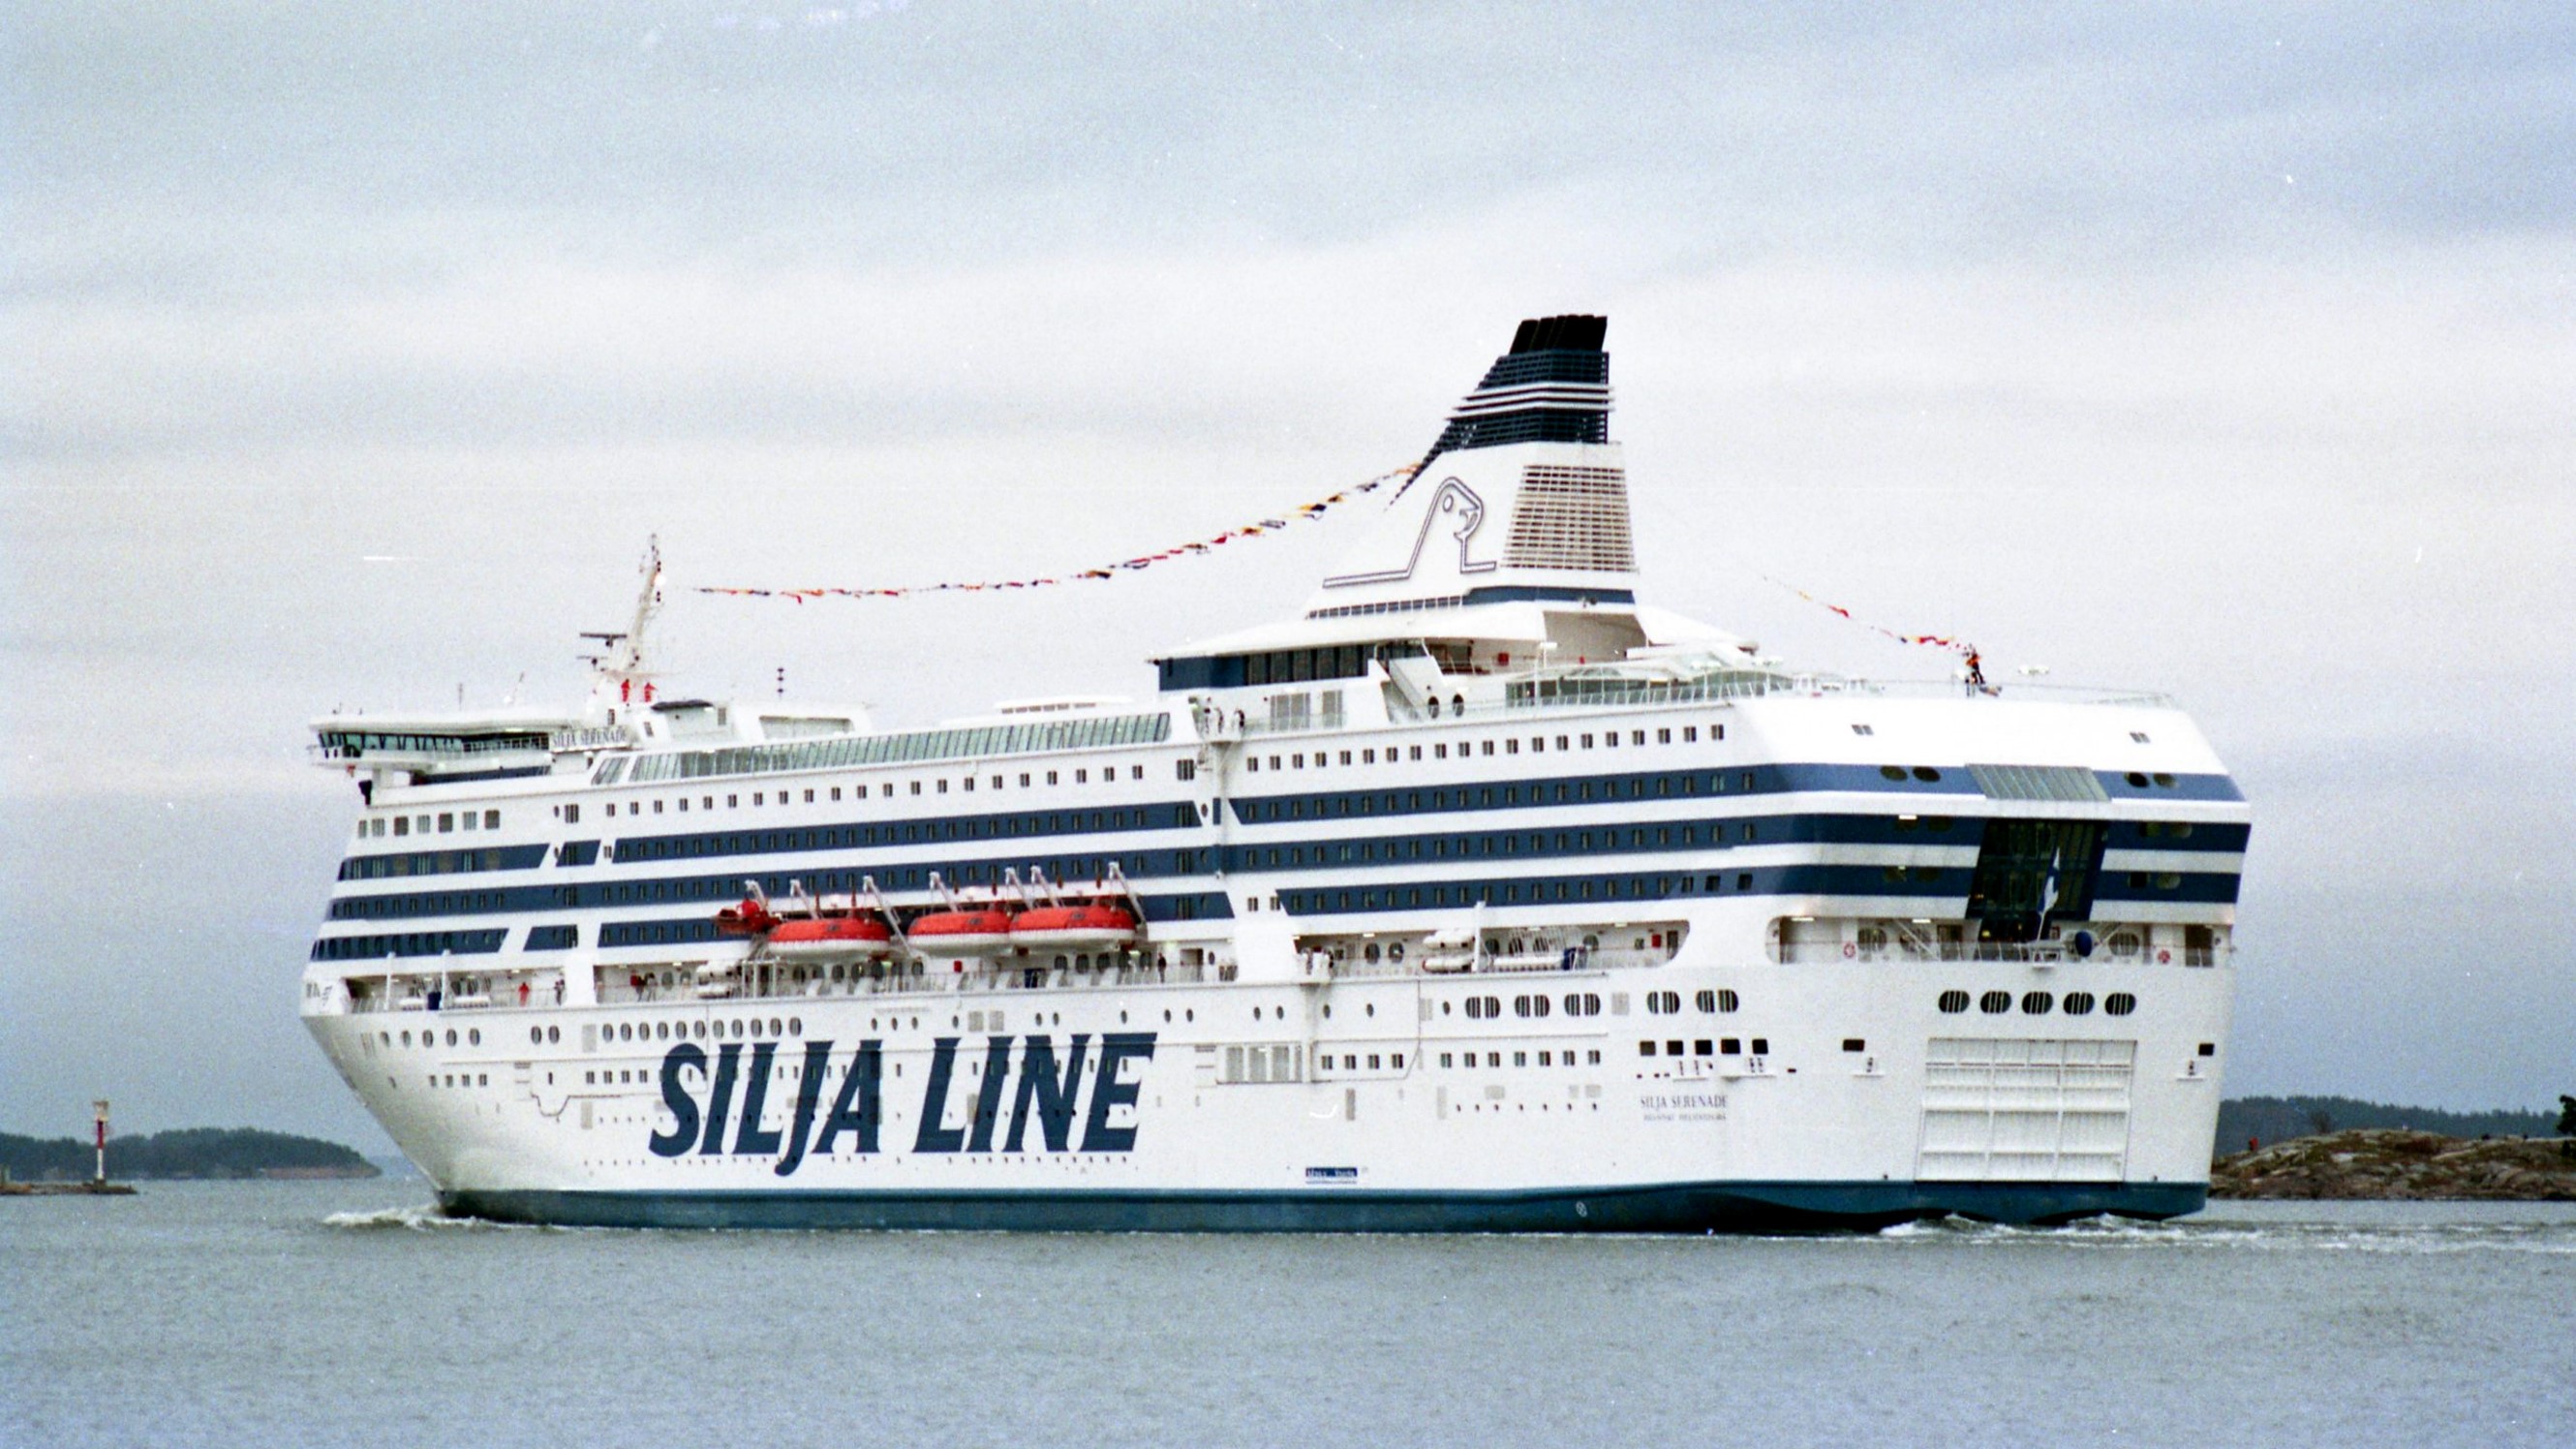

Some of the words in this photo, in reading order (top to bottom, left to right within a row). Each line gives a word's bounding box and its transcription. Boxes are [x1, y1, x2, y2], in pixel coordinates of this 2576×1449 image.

[648, 1038, 883, 1177] SILJA
[911, 1032, 1158, 1153] LINE
[1641, 1095, 1667, 1110] SILJA
